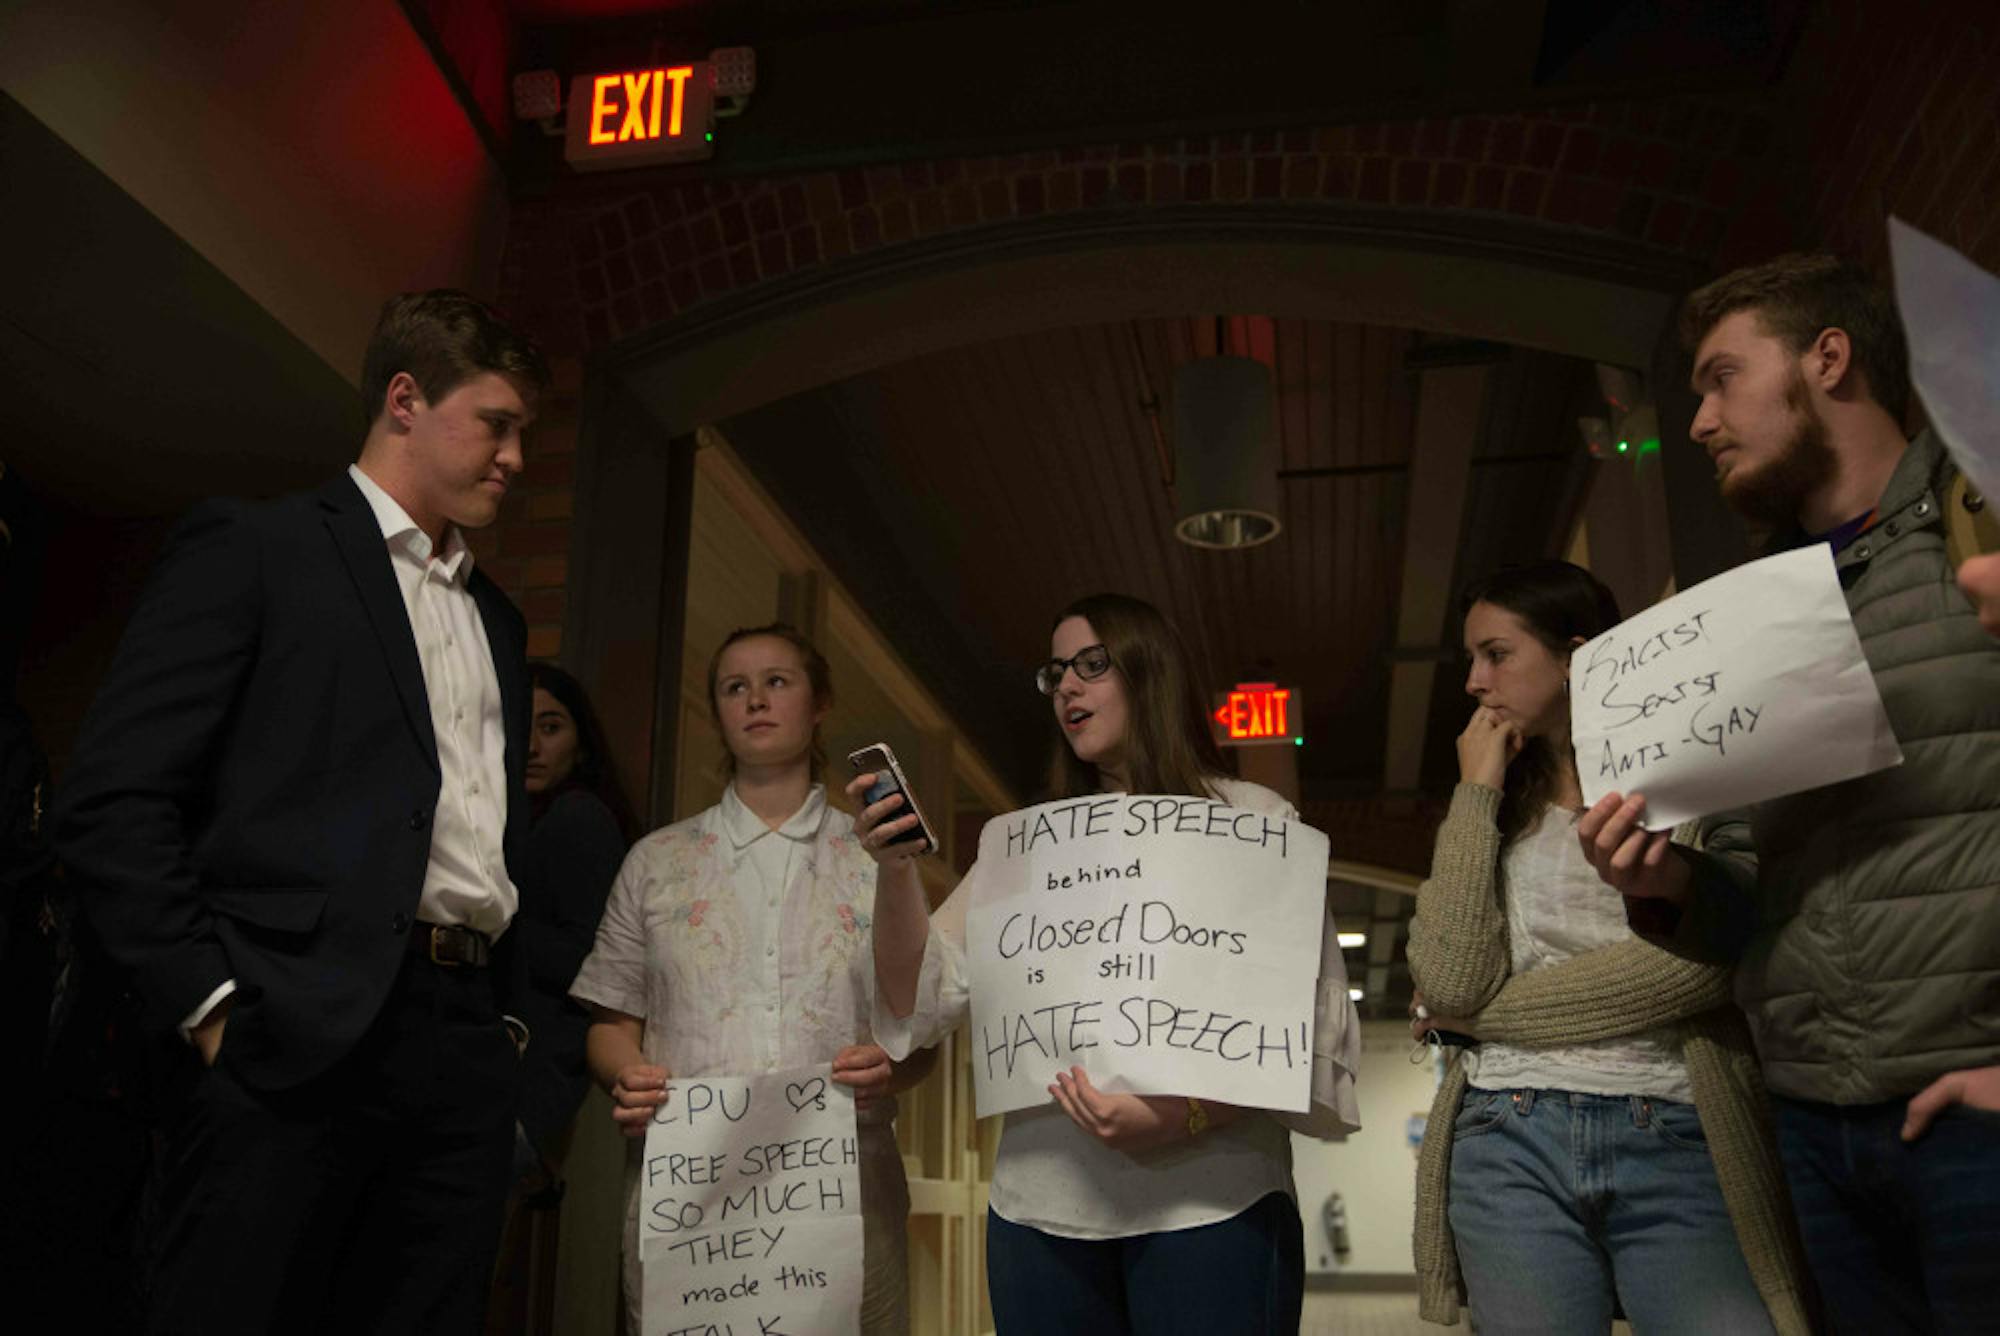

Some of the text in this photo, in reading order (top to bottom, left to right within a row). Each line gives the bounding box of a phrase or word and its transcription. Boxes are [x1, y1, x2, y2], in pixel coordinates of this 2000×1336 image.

[590, 65, 693, 145] EXIT
[1228, 688, 1290, 738] EXIT
[1006, 799, 1288, 858] HATE SPEECH
[1047, 858, 1142, 891] behind
[999, 901, 1247, 959] Closed Doors
[1027, 952, 1155, 984] is still
[983, 997, 1308, 1080] HATE SPEECH!
[647, 1137, 857, 1188] FREE SPEECH
[648, 1178, 844, 1233] SO MUCH
[668, 1226, 785, 1265] THEY
[682, 1265, 827, 1305] made this
